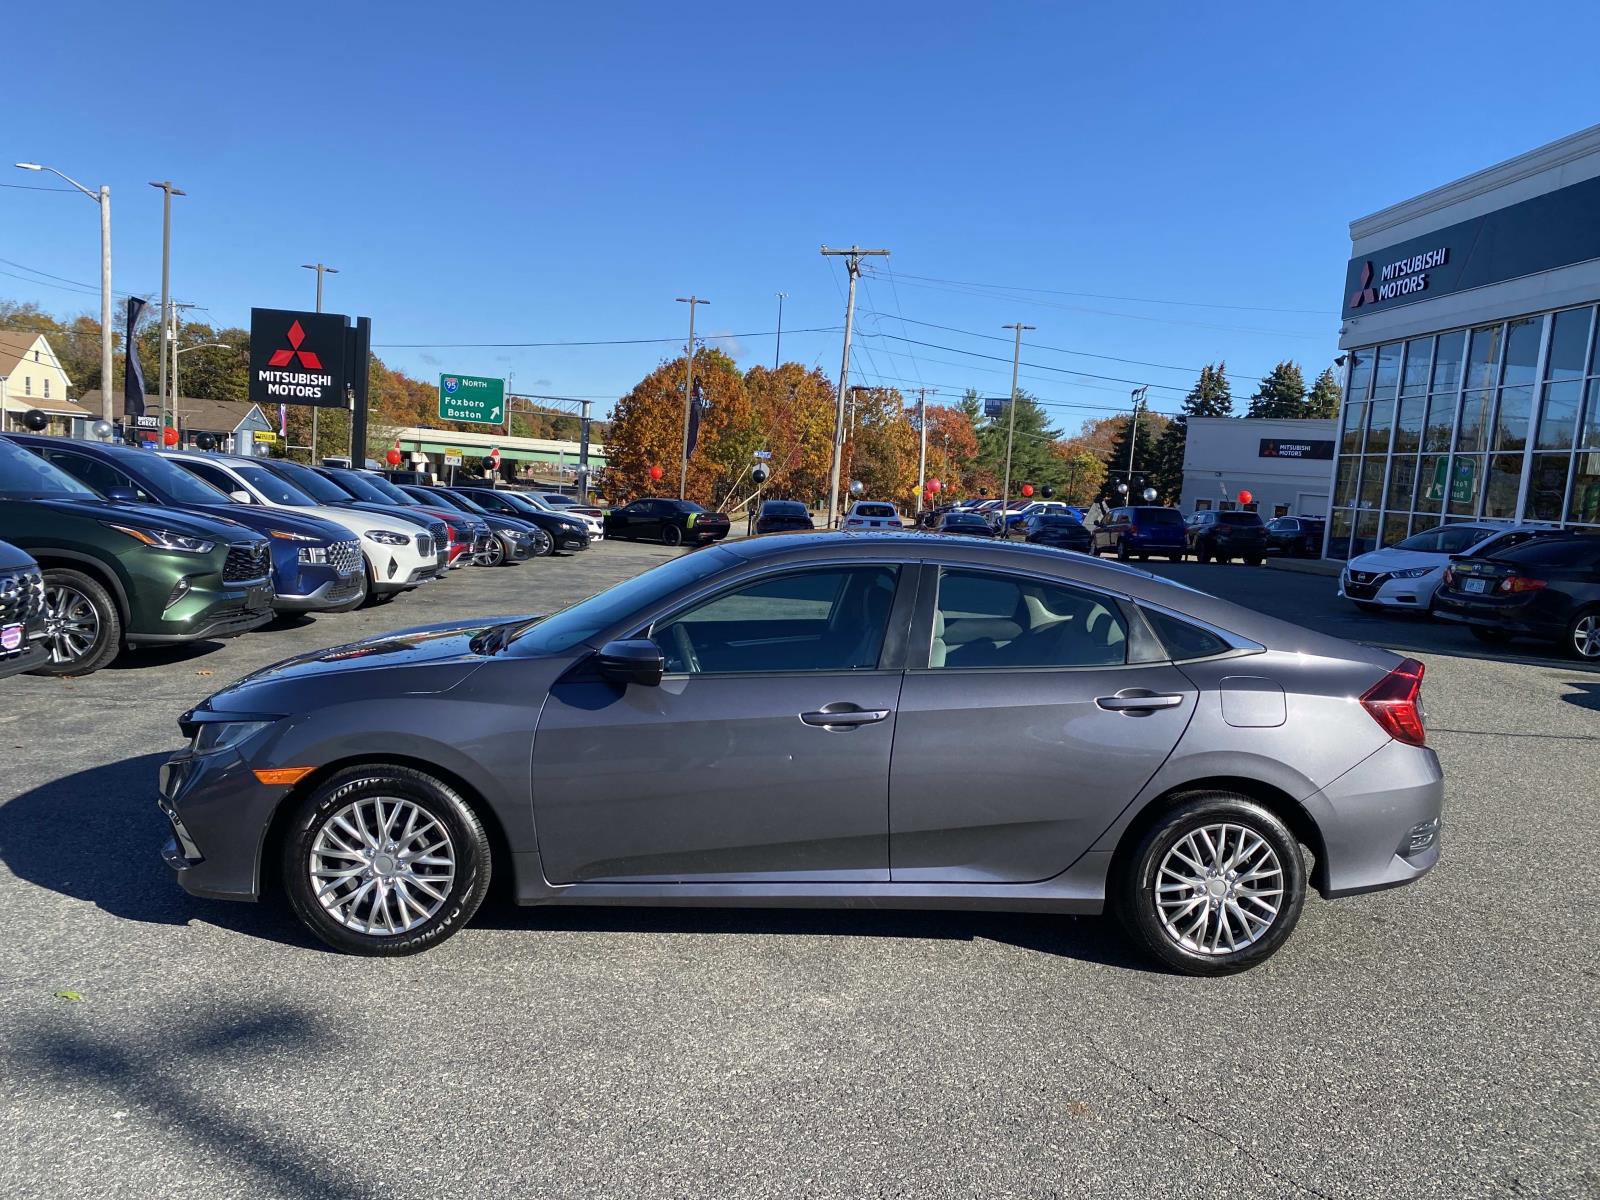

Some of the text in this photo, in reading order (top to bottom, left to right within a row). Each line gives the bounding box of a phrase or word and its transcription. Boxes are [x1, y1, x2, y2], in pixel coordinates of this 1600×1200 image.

[1381, 248, 1446, 281] MITSUBISHI
[1379, 274, 1426, 301] MOTORS
[258, 370, 332, 386] MITSUBISHI
[446, 381, 456, 390] 95
[267, 383, 322, 398] MOTORS
[445, 396, 485, 408] Foxboro
[447, 408, 482, 419] Boston
